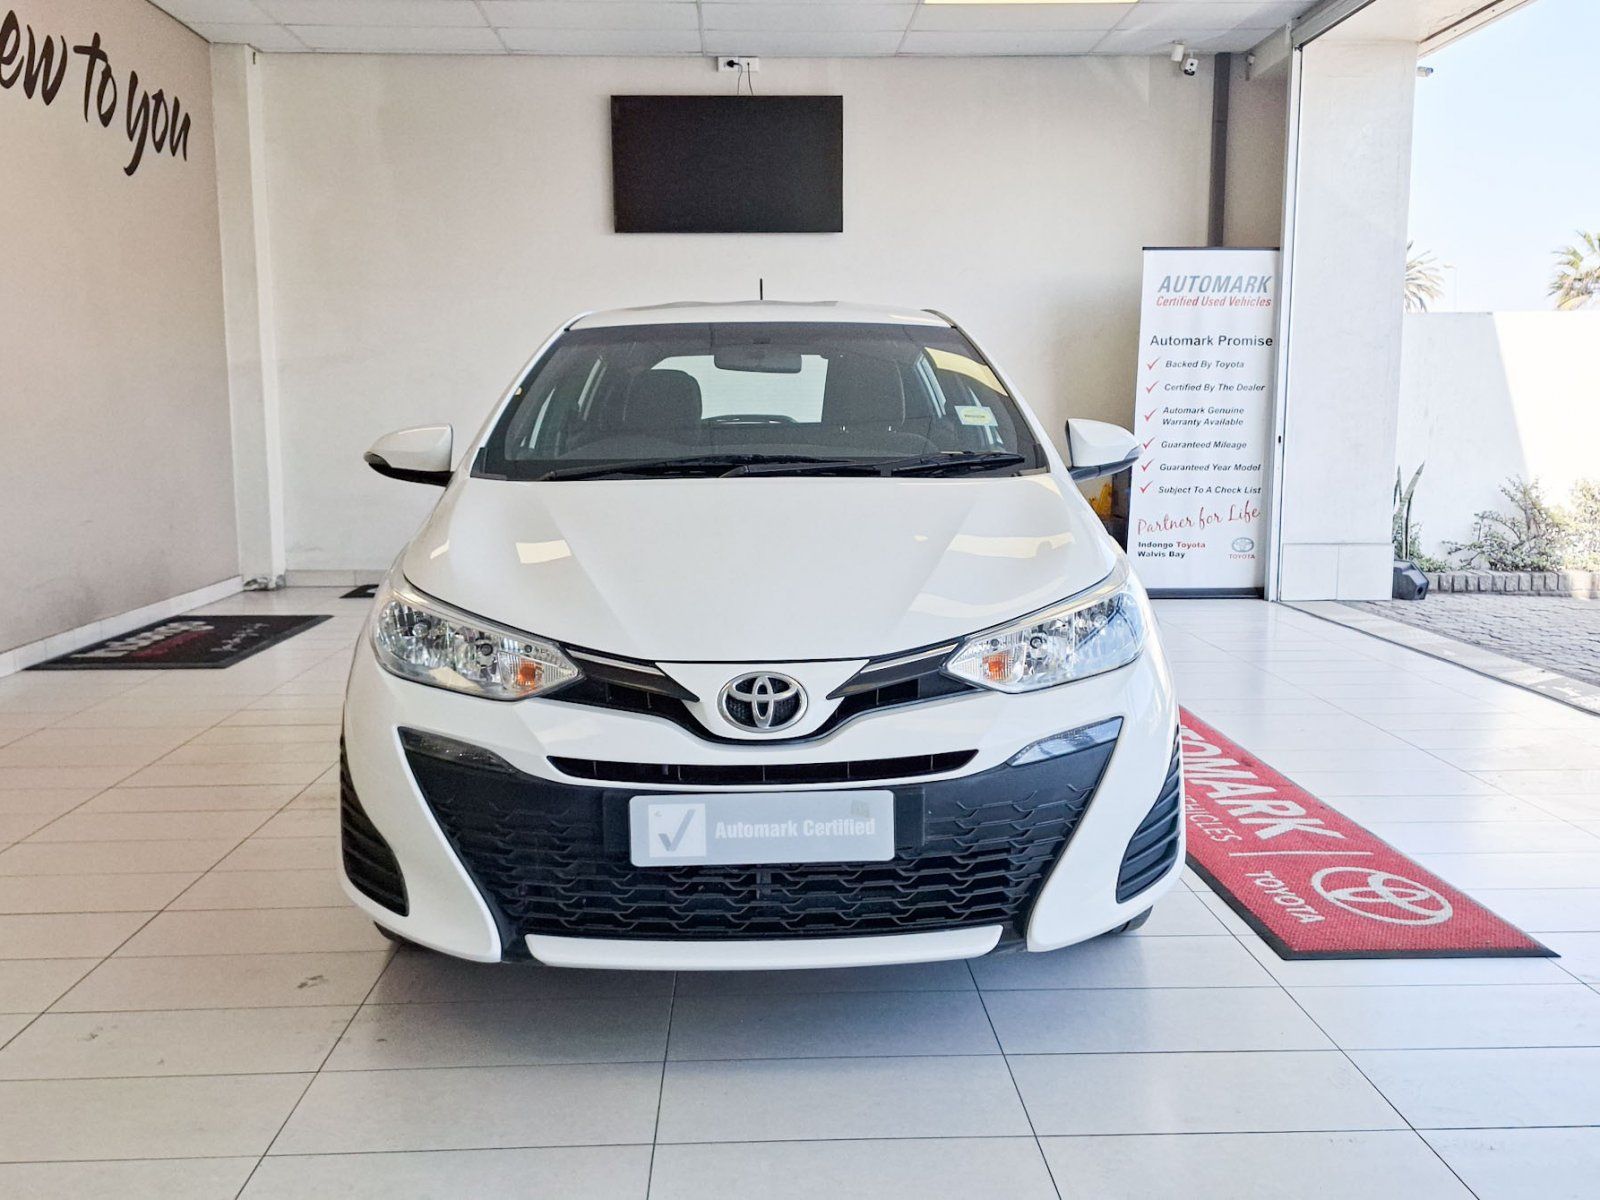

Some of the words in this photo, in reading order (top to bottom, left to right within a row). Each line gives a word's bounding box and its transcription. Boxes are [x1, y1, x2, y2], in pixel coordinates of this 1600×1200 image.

[73, 32, 117, 128] to
[123, 70, 191, 176] you
[1157, 275, 1272, 293] AUTOMARK
[1156, 296, 1199, 307] Certified
[1201, 296, 1226, 307] Used
[1229, 296, 1272, 307] Vehicles
[1150, 335, 1214, 346] Automark
[1218, 335, 1273, 347] Promise
[1165, 360, 1198, 368] Backed
[1200, 360, 1212, 370] By
[1215, 360, 1245, 370] Toyota
[1164, 383, 1201, 391] Certified
[1204, 383, 1215, 393] By
[1218, 383, 1234, 391] The
[1236, 383, 1266, 391] Dealer
[1162, 406, 1205, 414] Automark
[1207, 406, 1245, 414] Genuine
[1162, 418, 1201, 427] Warranty
[1203, 418, 1244, 426] Available
[1161, 440, 1211, 449] Guaranteed
[1213, 440, 1247, 450] Mileage
[1159, 463, 1210, 471] Guaranteed
[1212, 463, 1231, 471] Year
[1233, 463, 1261, 471] Model
[1158, 486, 1191, 495] Subject
[1194, 486, 1204, 494] To
[1206, 486, 1212, 494] A
[1215, 486, 1241, 494] Check
[1244, 486, 1262, 494] List
[1137, 513, 1194, 535] Partner
[1199, 506, 1222, 530] for
[1228, 500, 1261, 523] Life
[1138, 541, 1174, 549] Indongo
[1176, 541, 1206, 550] Toyota
[1169, 551, 1186, 559] Bay
[715, 819, 798, 839] Automark
[802, 818, 877, 837] Certified
[1245, 870, 1326, 924] TOYOTA
